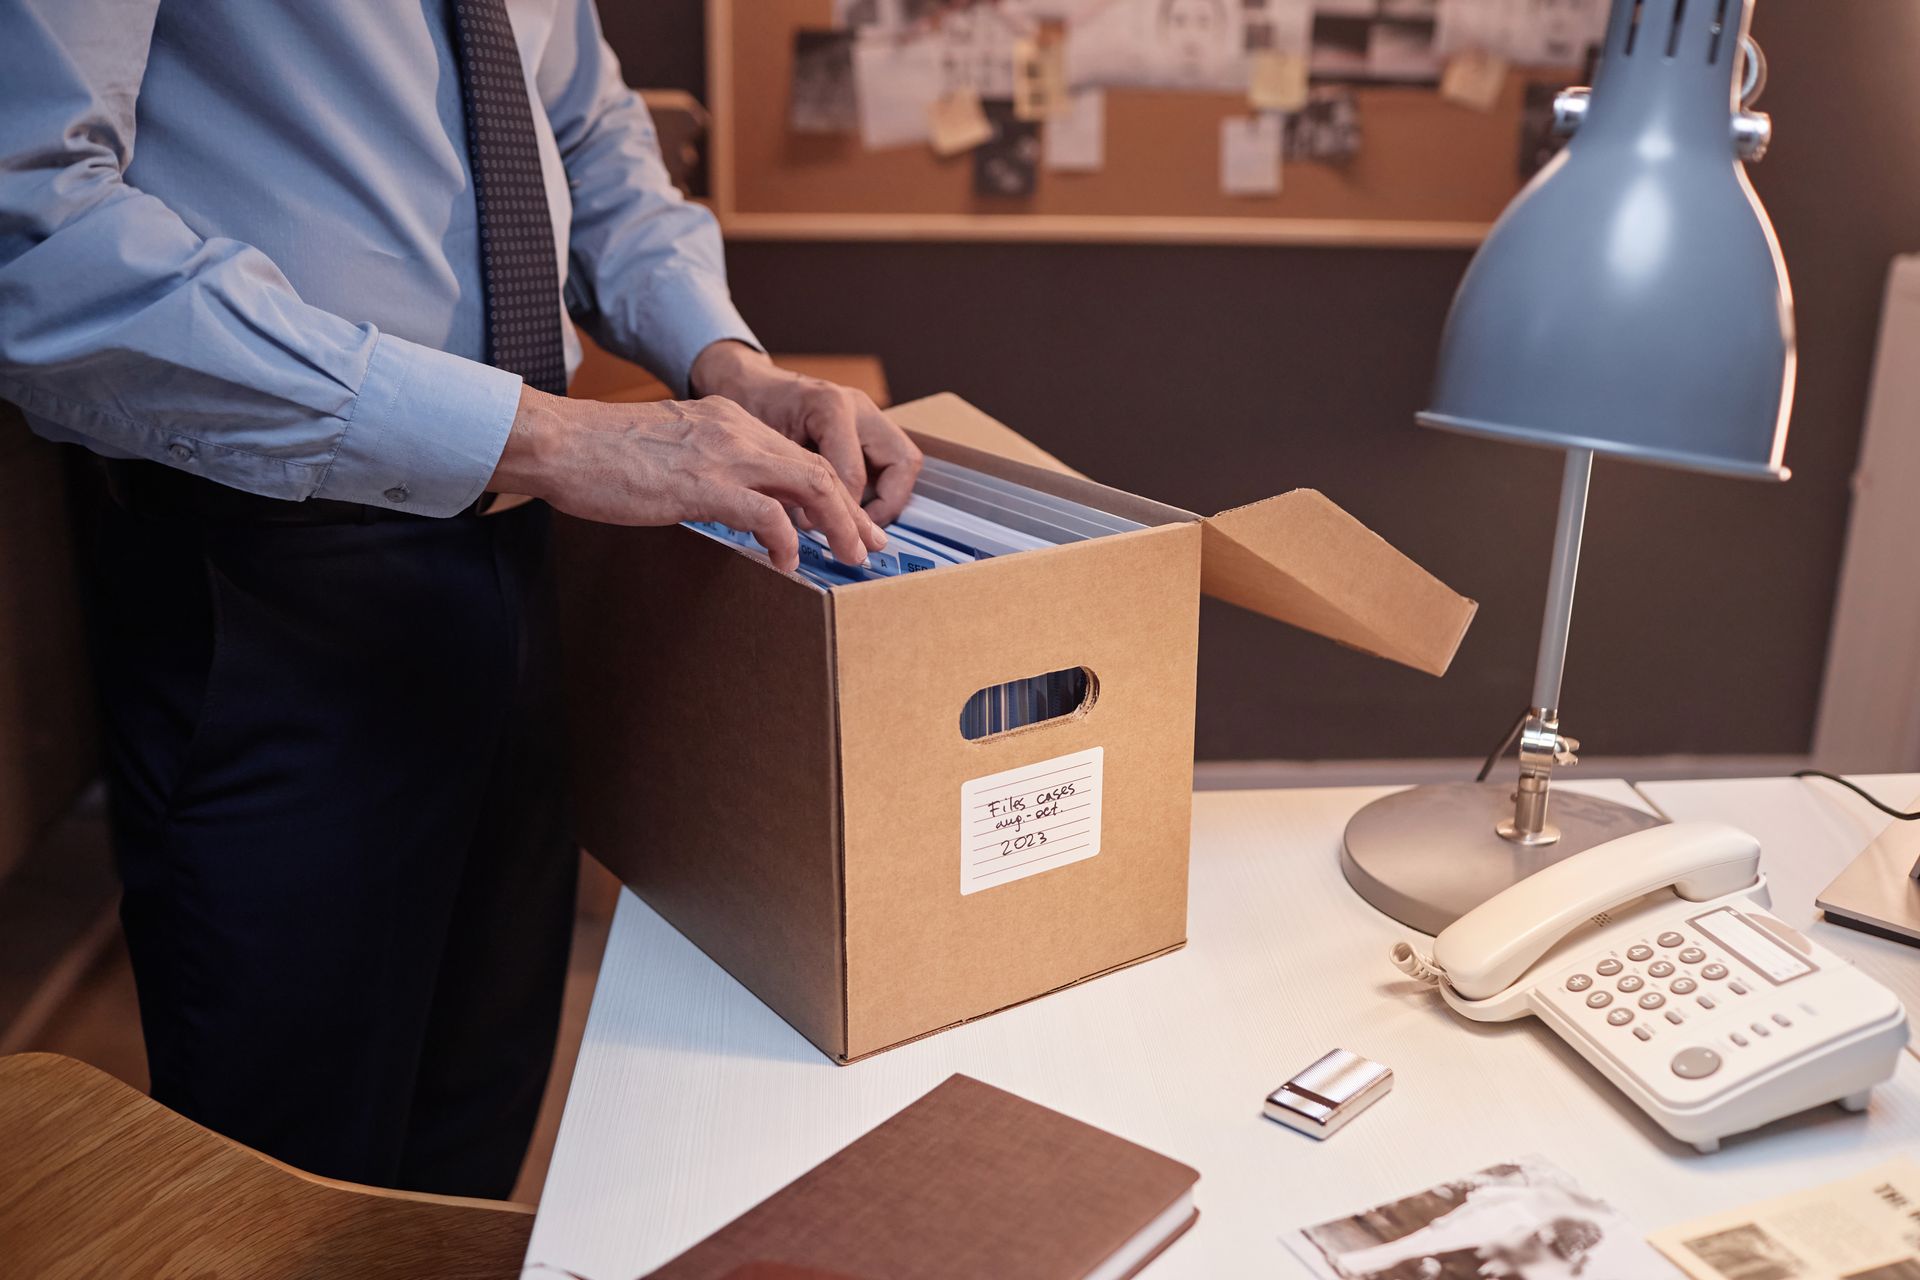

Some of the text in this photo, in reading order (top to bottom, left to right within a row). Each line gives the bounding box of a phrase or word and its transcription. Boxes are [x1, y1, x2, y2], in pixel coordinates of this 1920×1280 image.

[988, 783, 1076, 818] Files cases
[1000, 831, 1048, 857] 2023
[1600, 960, 1617, 970] 7
[1621, 976, 1639, 988] 8
[1631, 947, 1648, 957] 4
[1651, 962, 1672, 973] 5
[1683, 948, 1701, 960] 2
[1705, 964, 1725, 976] 3
